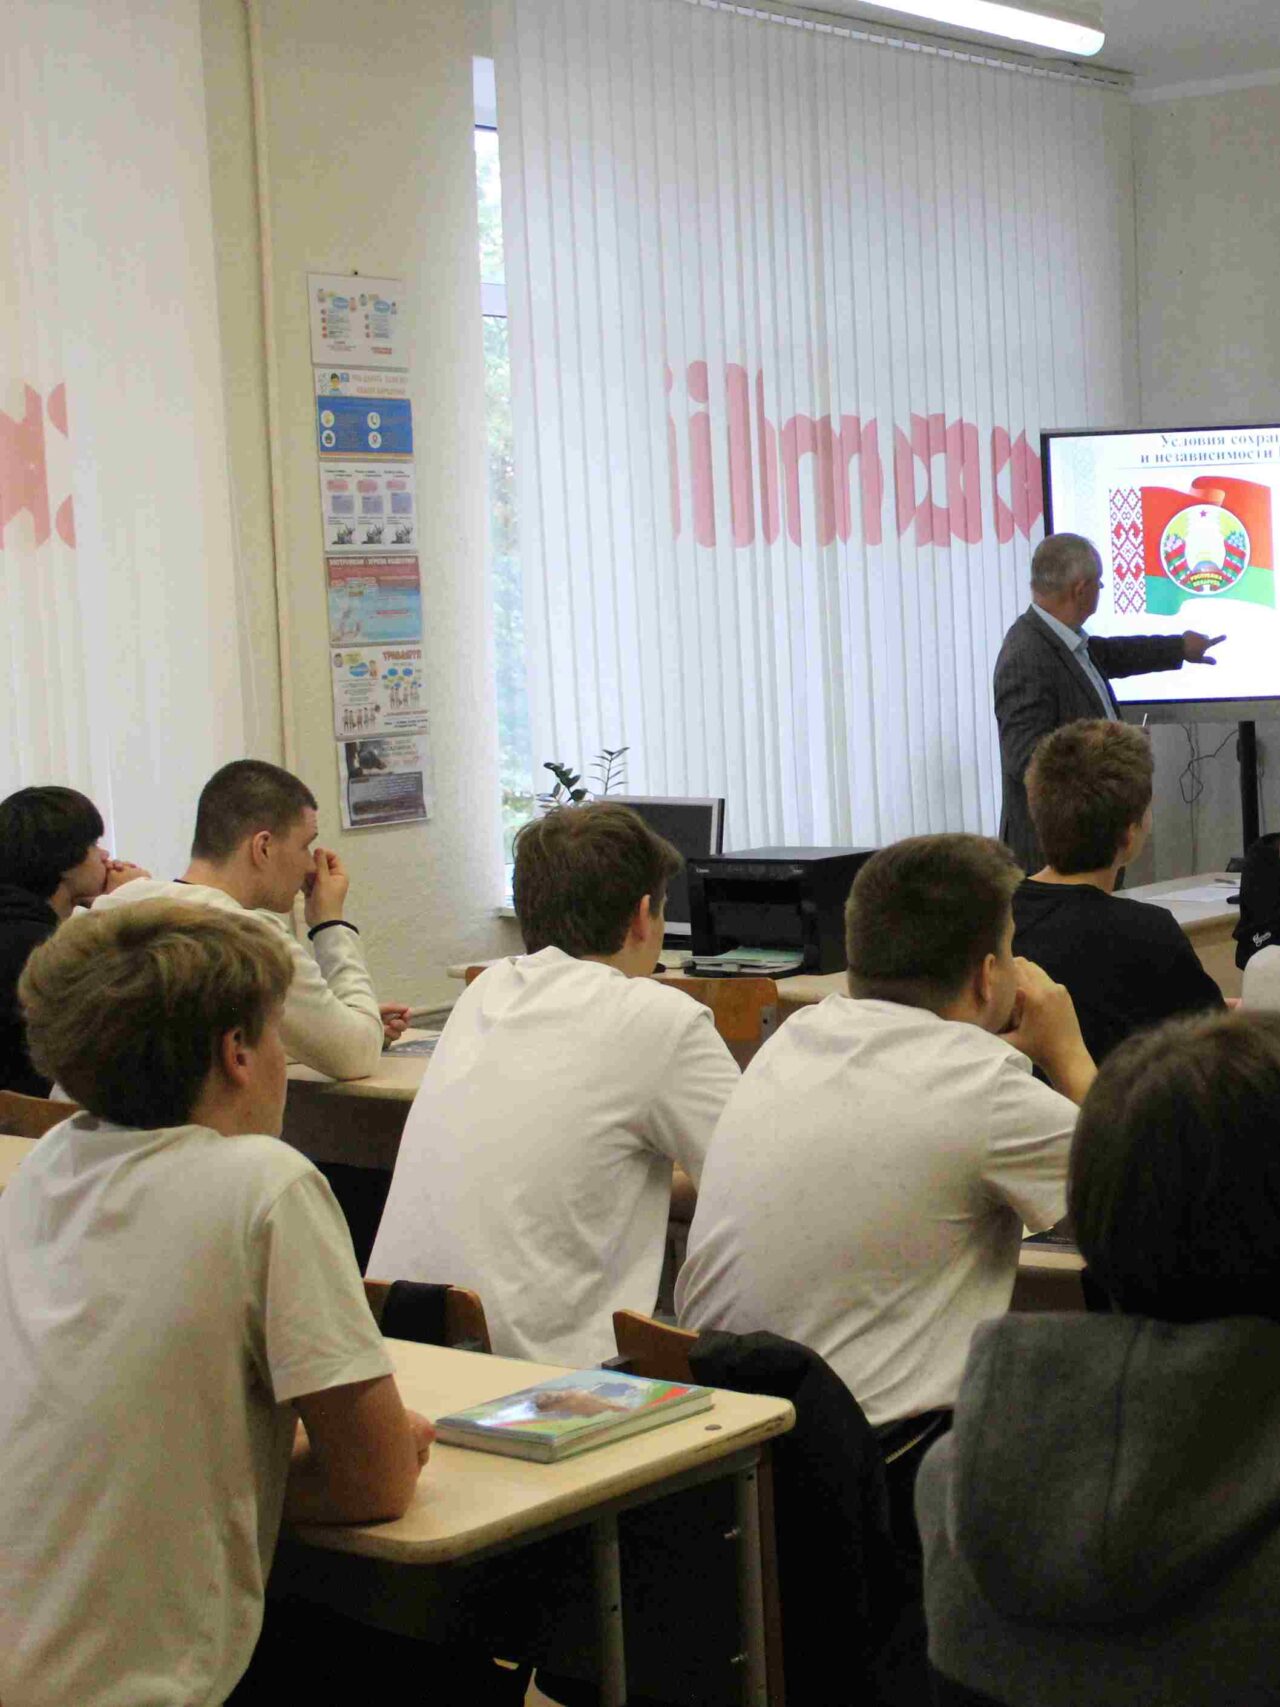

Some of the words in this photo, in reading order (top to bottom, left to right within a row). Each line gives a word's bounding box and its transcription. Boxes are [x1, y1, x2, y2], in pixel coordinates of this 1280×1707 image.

[1160, 434, 1225, 448] Условия
[1140, 454, 1149, 463] и
[1155, 449, 1273, 464] независимости
